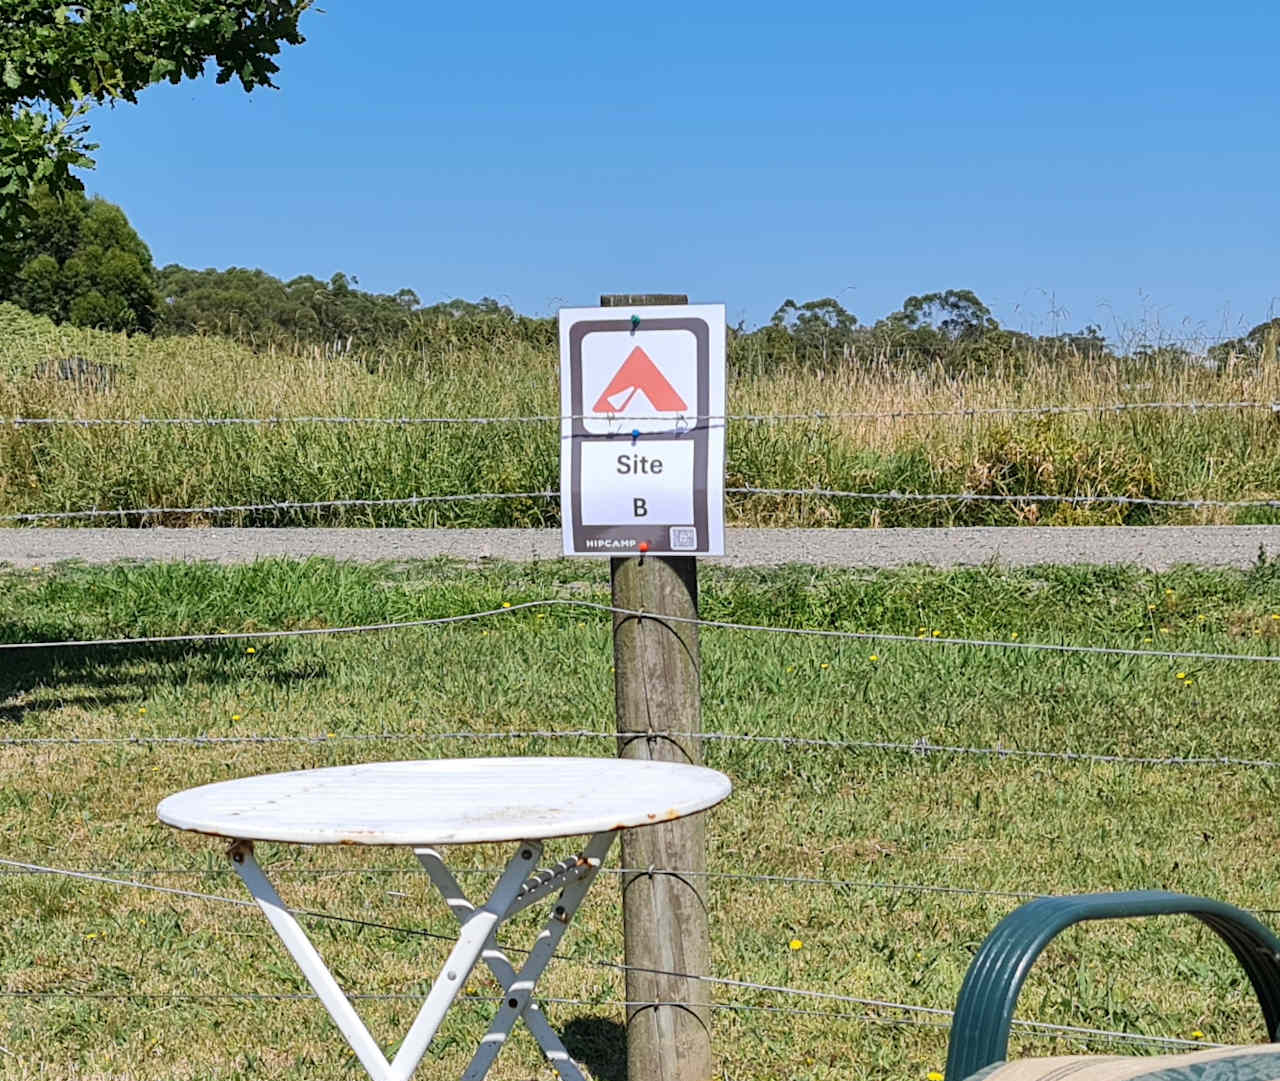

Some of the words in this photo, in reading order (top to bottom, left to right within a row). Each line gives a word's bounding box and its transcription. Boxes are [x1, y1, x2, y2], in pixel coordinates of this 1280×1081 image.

[616, 454, 663, 475] Site
[633, 498, 648, 517] B
[585, 539, 636, 548] HIPCAMP
